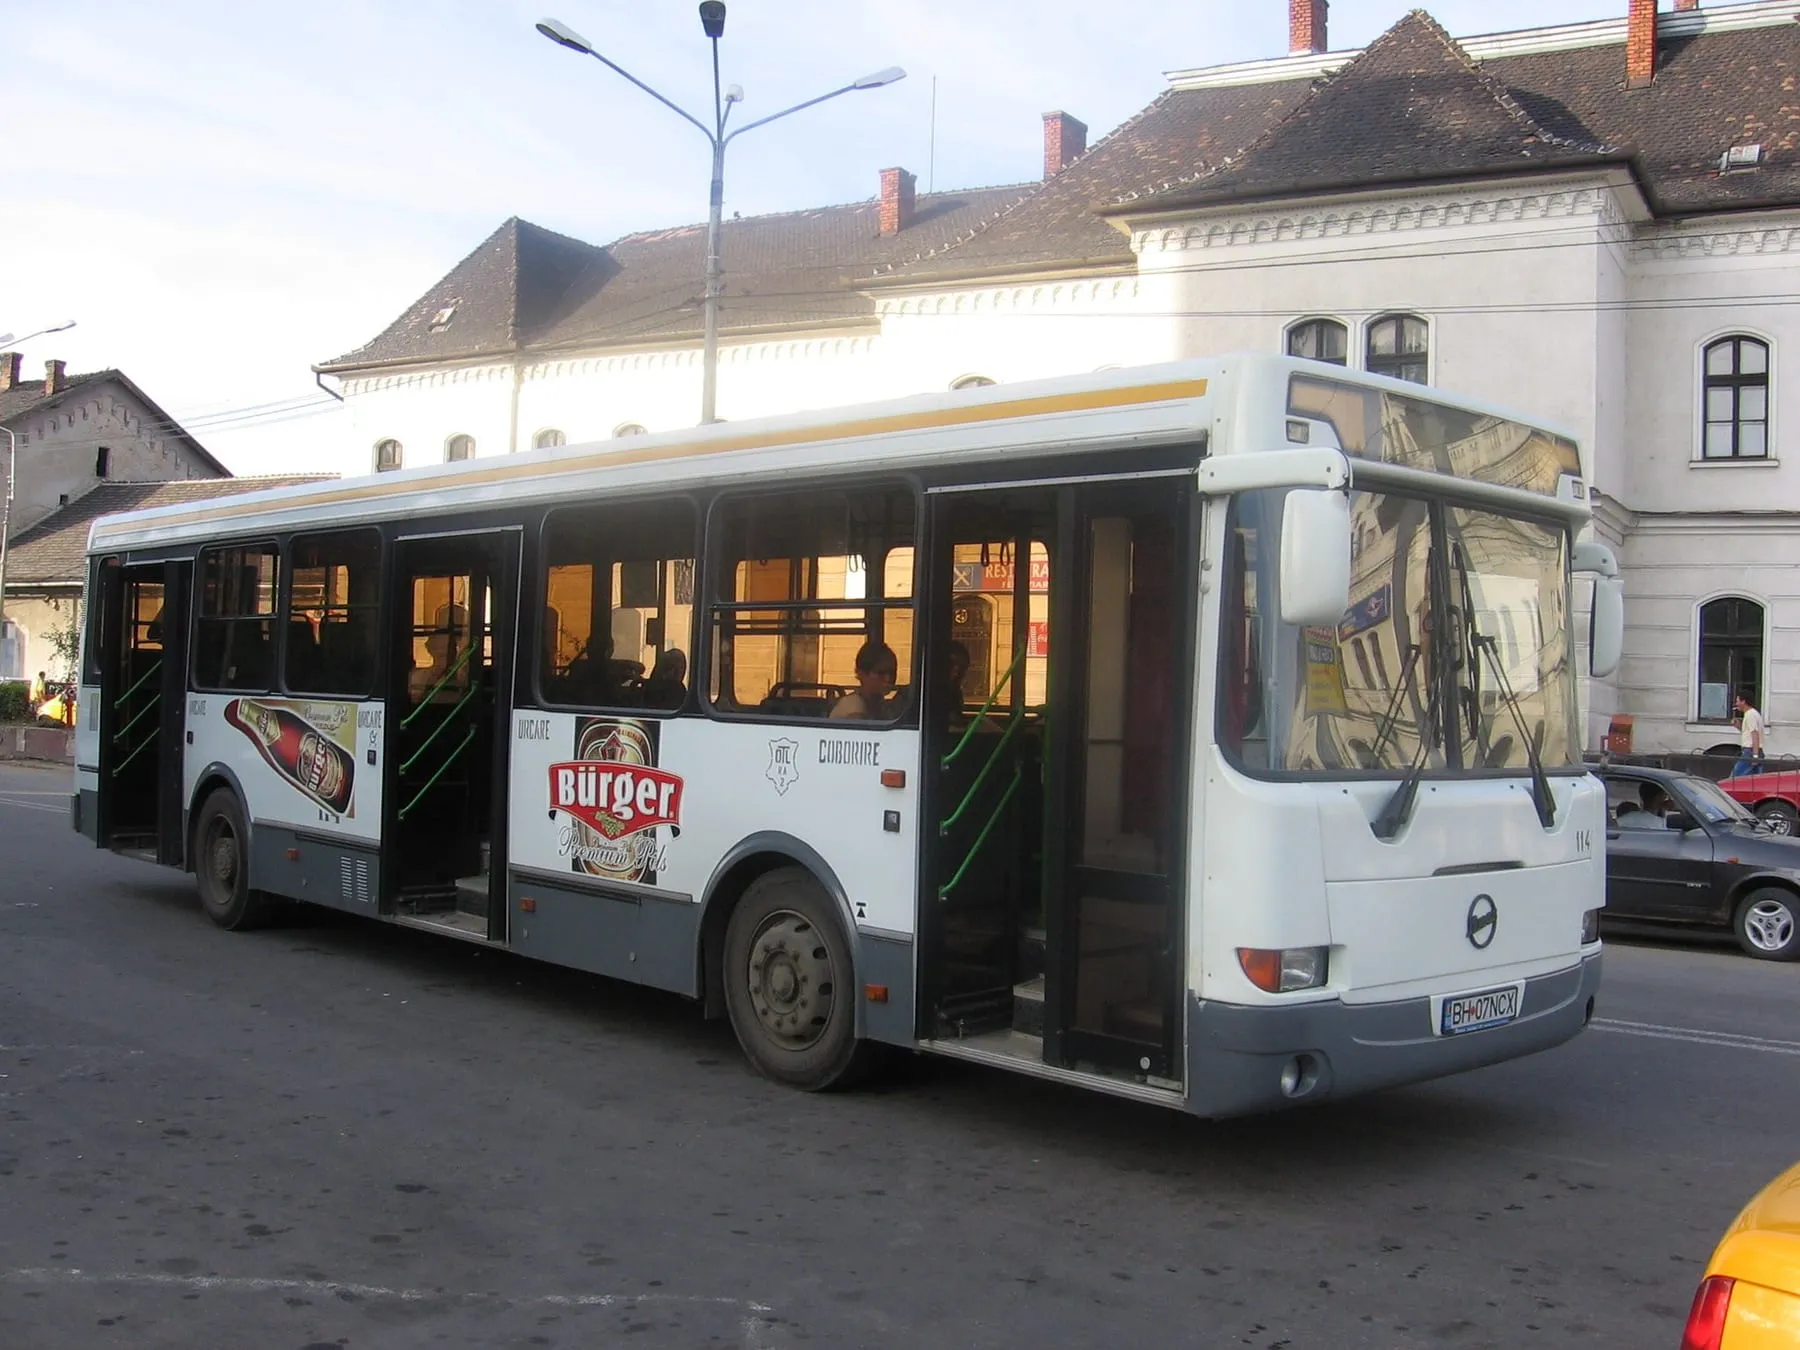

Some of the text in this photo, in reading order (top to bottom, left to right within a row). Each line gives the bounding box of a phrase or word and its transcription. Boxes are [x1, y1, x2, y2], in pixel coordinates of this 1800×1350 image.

[558, 766, 675, 820] Bürger
[559, 825, 668, 872] Premium Pils
